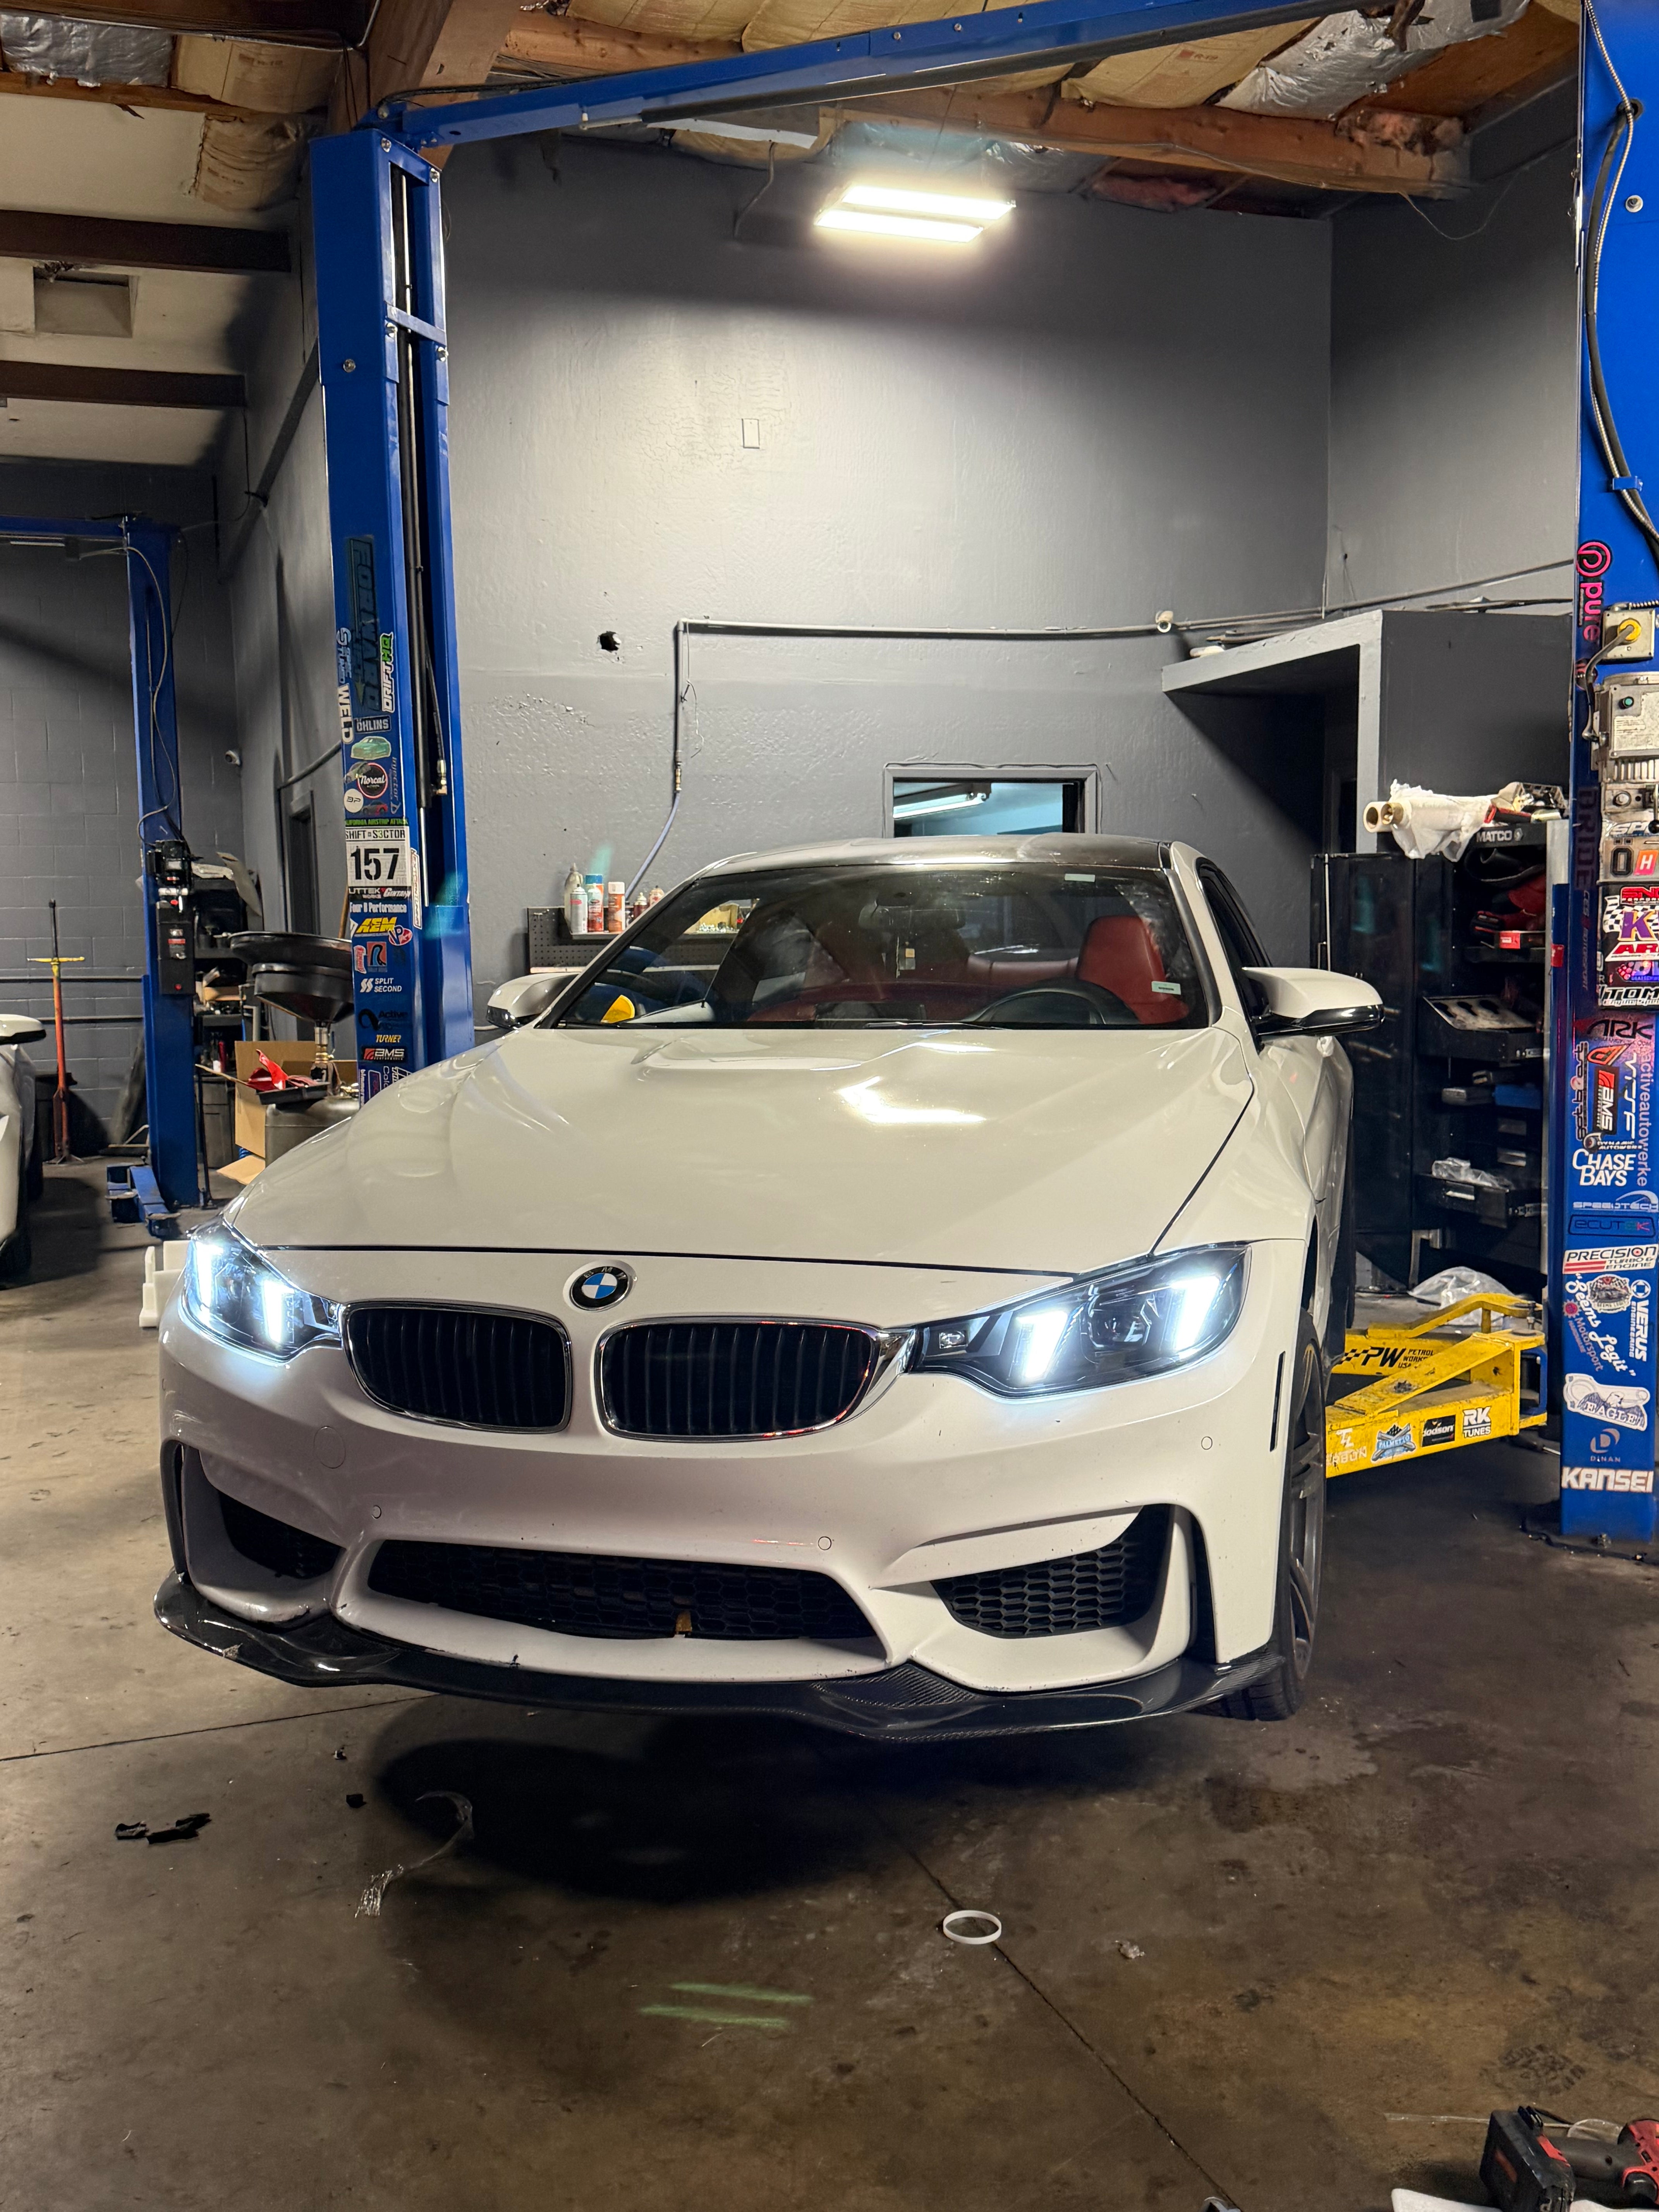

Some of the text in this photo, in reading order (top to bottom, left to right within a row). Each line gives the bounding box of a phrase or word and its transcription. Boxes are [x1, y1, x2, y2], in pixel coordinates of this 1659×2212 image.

[1576, 582, 1602, 641] pure
[338, 685, 353, 744] WELD
[360, 775, 385, 785] Norcal
[1476, 831, 1512, 842] MATCO
[350, 848, 399, 880] 157
[356, 917, 397, 933] AEM
[376, 1034, 401, 1042] TURNER
[1573, 1149, 1636, 1170] CHASE
[1580, 1165, 1627, 1186] BAYS
[1567, 1247, 1657, 1261] PRECISION
[583, 1267, 627, 1279] BMW
[1635, 1299, 1649, 1362] VERUS
[1575, 1317, 1604, 1372] Motorsport
[1361, 1346, 1407, 1367] PW
[1463, 1407, 1491, 1425] RK
[1585, 1401, 1637, 1425] EAGLE
[1463, 1427, 1491, 1438] TUNES
[1561, 1467, 1654, 1493] KANSEI
